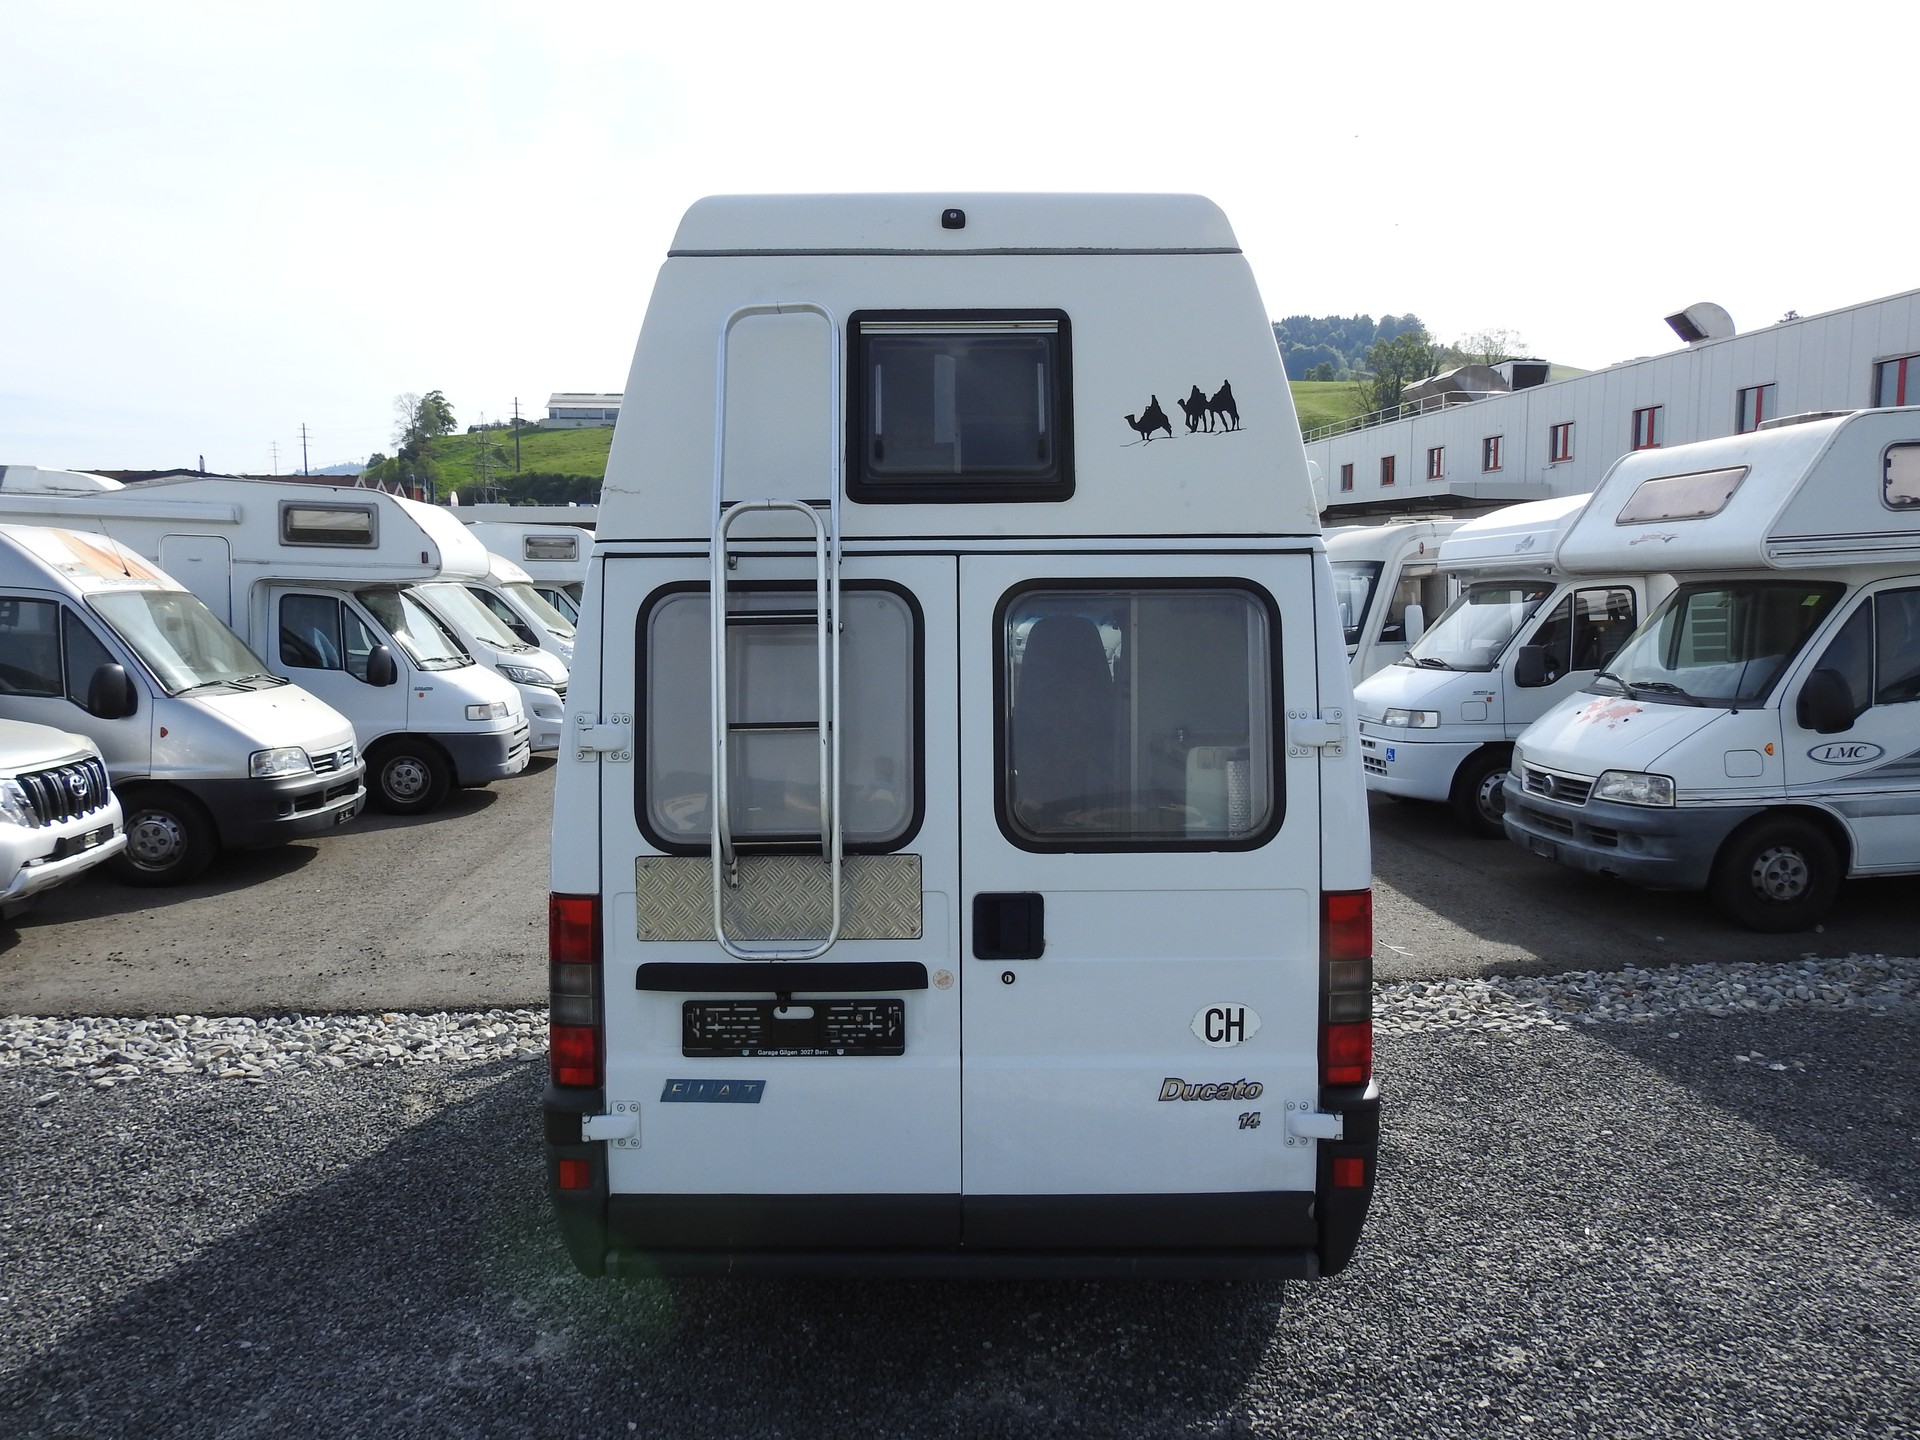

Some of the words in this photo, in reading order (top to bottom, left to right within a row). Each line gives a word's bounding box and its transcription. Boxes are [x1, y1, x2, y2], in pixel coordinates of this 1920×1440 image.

[1824, 746, 1867, 759] LMC
[1205, 1007, 1245, 1043] CH
[757, 1049, 779, 1057] Garage
[671, 1082, 758, 1097] FIAT
[1158, 1077, 1263, 1102] Ducato
[1238, 1111, 1261, 1130] 14
